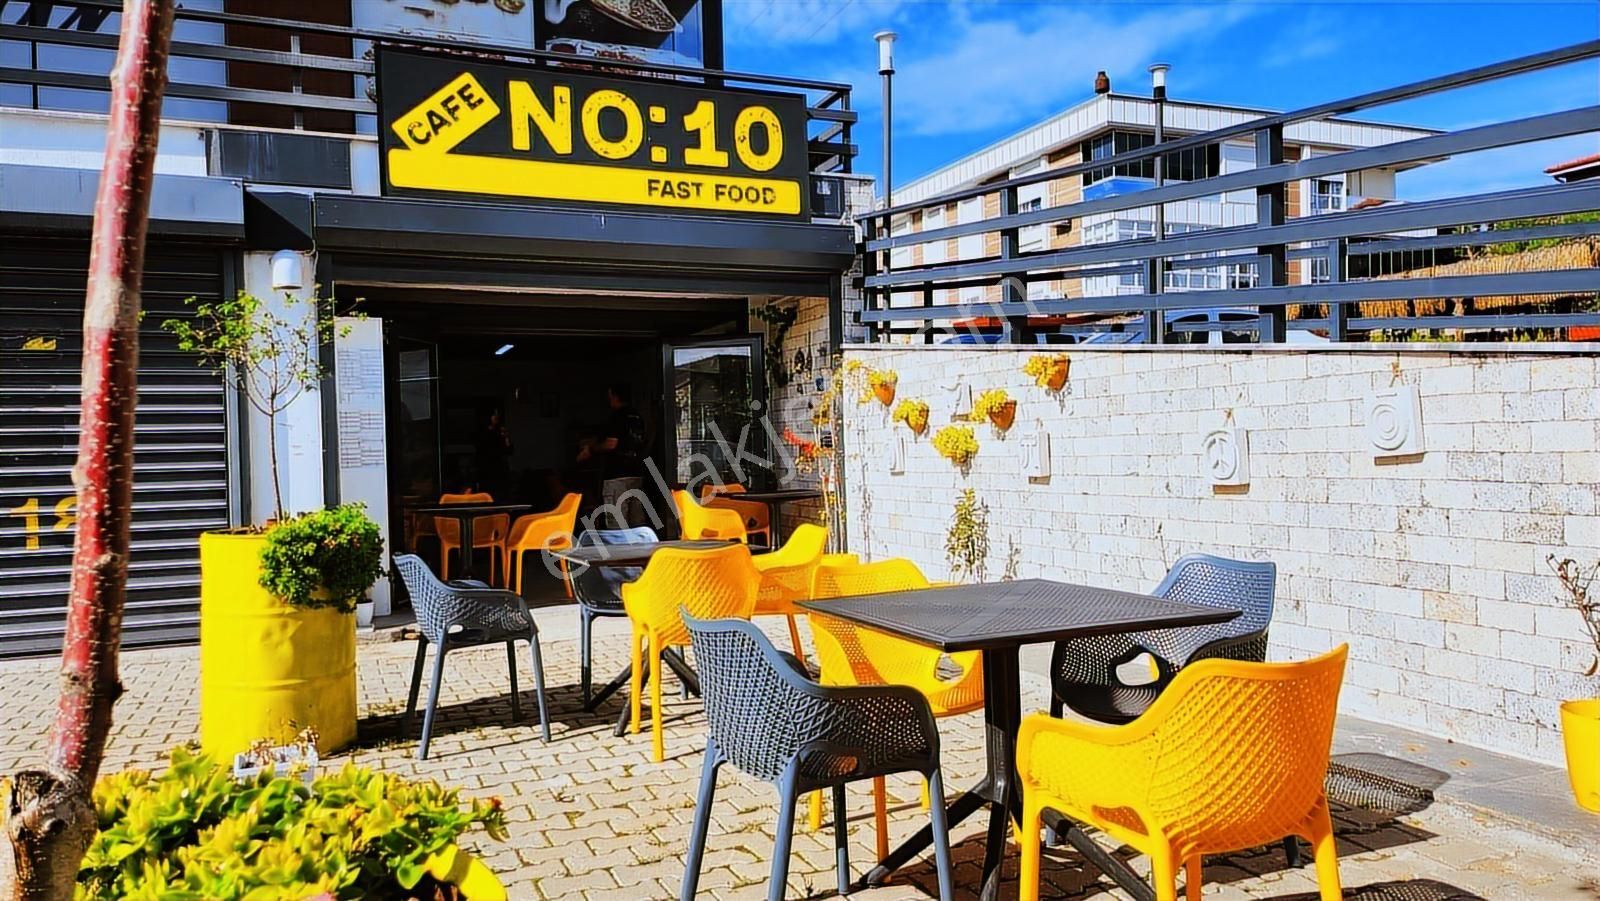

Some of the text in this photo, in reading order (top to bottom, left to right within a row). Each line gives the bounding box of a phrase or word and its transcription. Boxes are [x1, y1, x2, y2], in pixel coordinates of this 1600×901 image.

[407, 82, 485, 145] CAFE
[507, 79, 785, 172] NO:10
[647, 178, 777, 205] FAST FOOD
